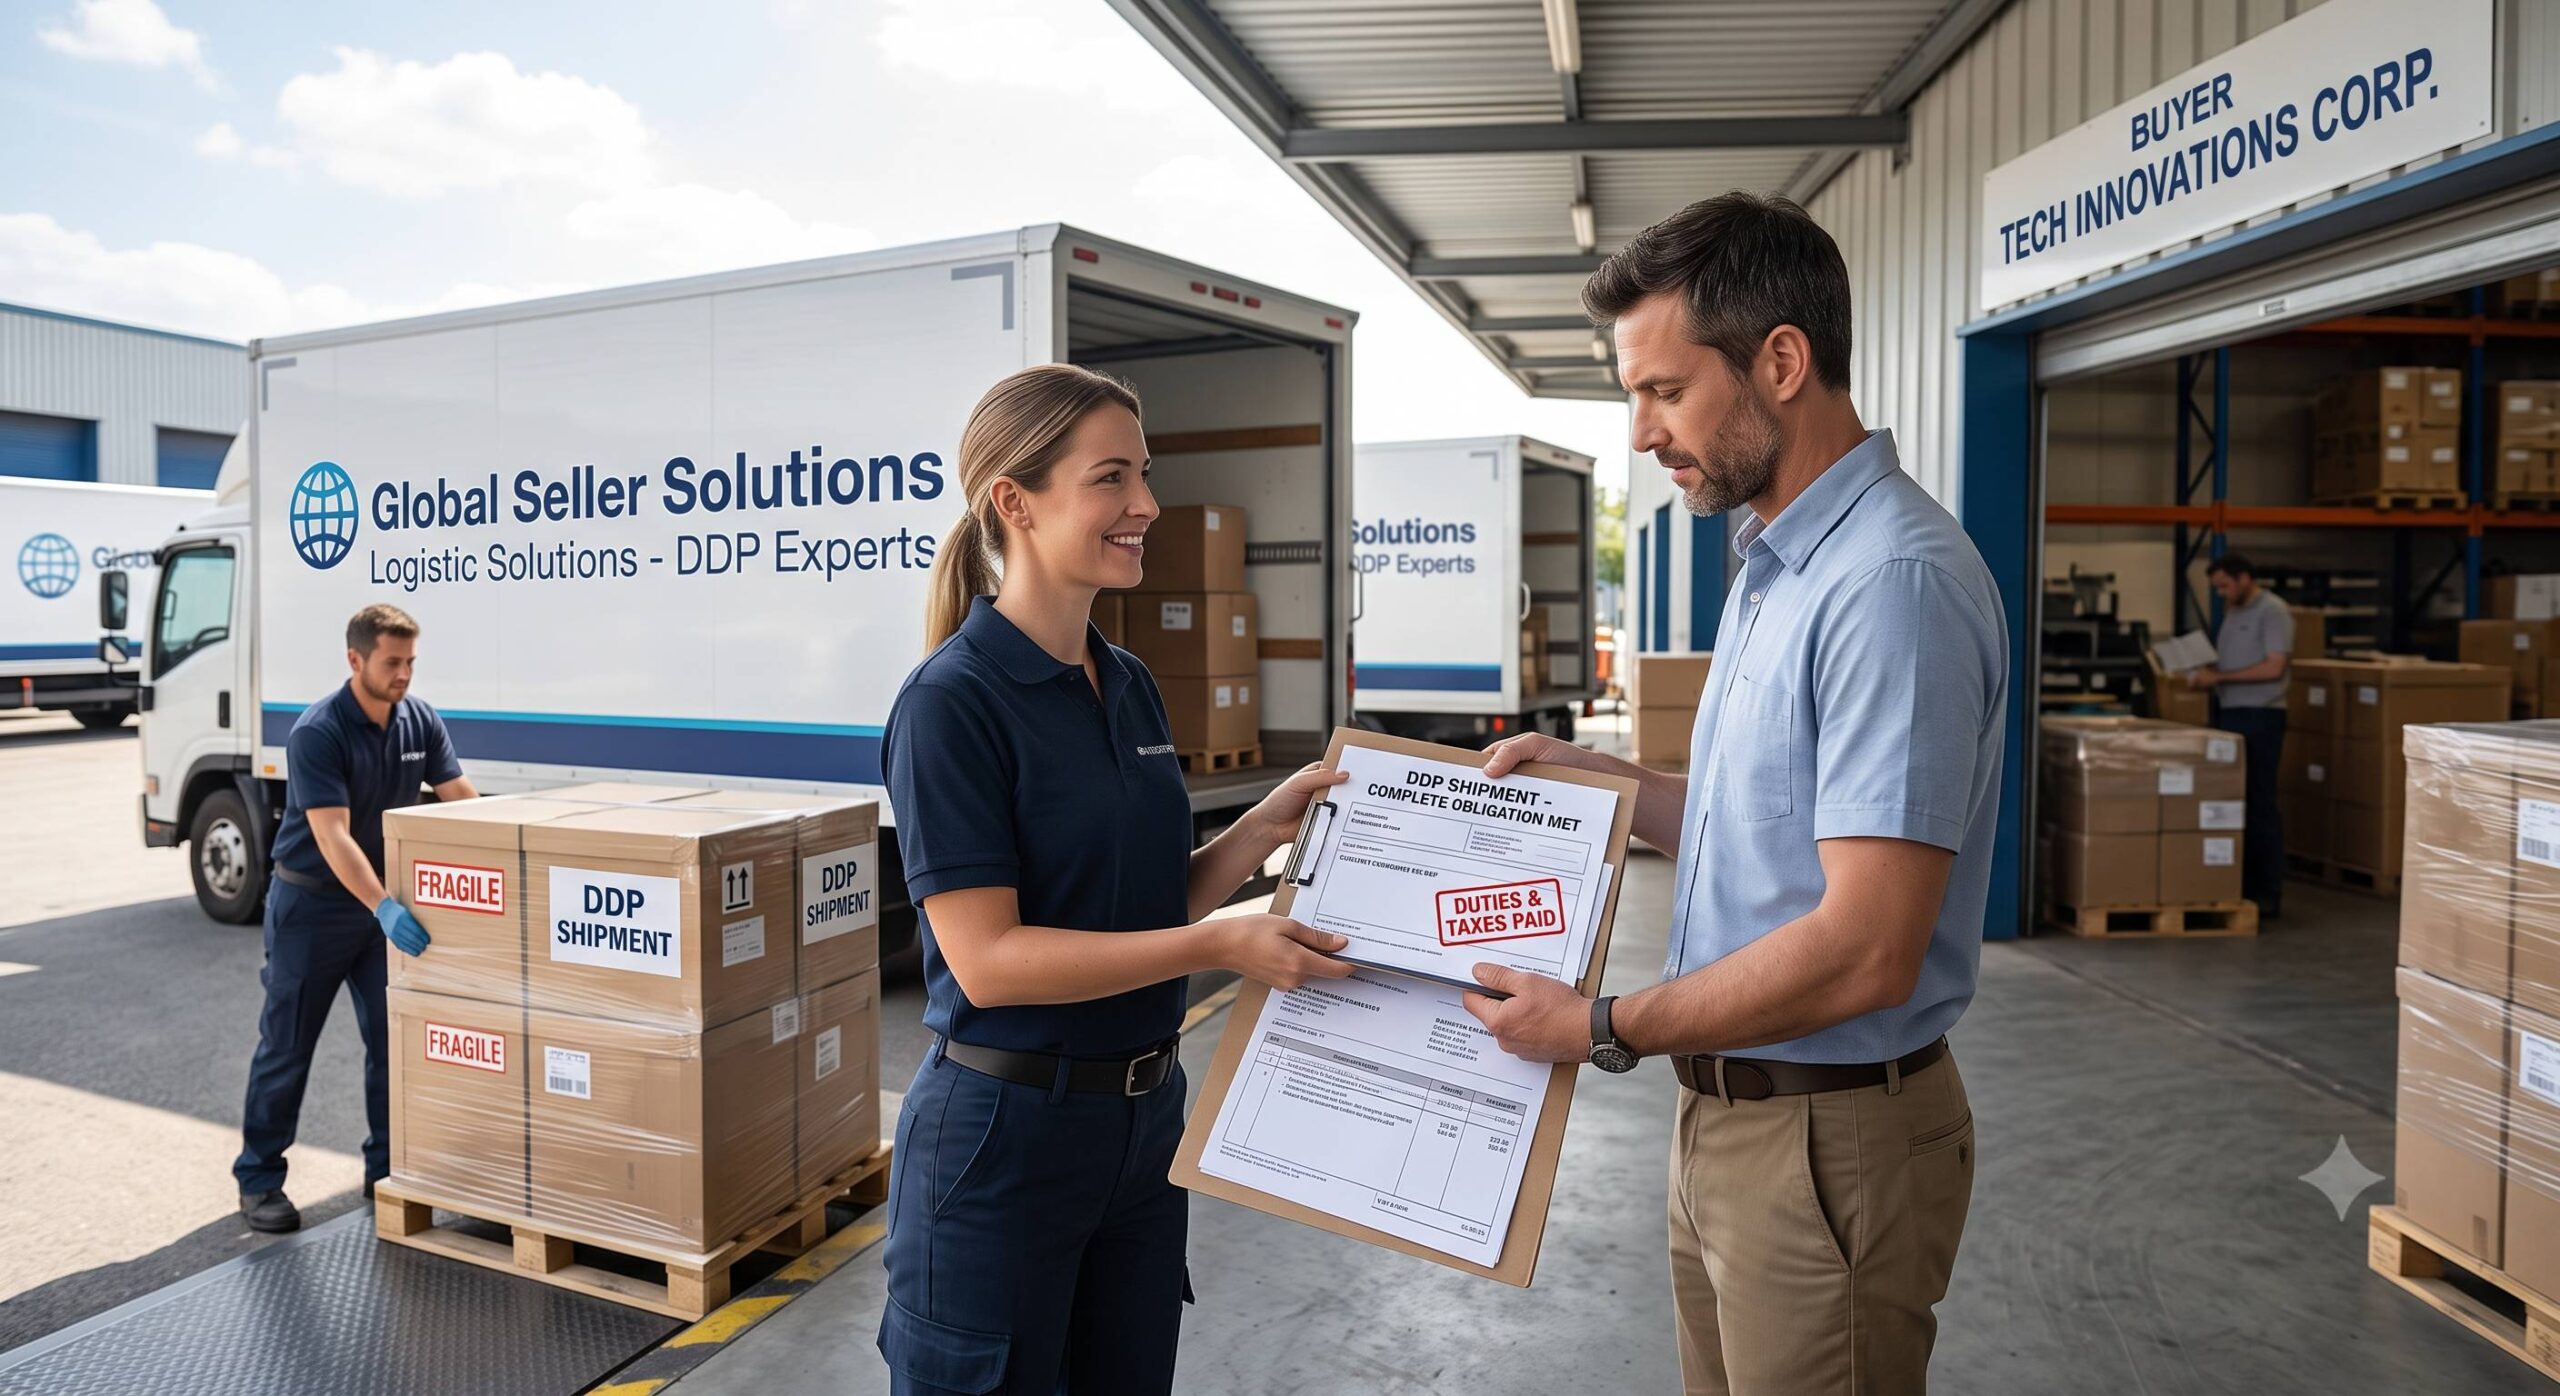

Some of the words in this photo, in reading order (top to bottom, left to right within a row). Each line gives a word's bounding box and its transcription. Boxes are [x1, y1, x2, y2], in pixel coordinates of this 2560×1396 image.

[2131, 72, 2234, 153] BUYER
[1999, 199, 2067, 265] TECH
[2076, 104, 2299, 238] INNOVATIONS
[2312, 47, 2439, 142] CORP.
[371, 473, 498, 532] Global
[512, 462, 648, 529] Seller
[662, 451, 944, 515] Solutions
[371, 543, 478, 593] Logistic
[487, 542, 638, 582] Solutions
[677, 532, 761, 577] DDP
[775, 527, 936, 583] Experts
[1397, 554, 1475, 579] Experts
[1406, 770, 1444, 789] DDP
[1447, 778, 1541, 806] SHIPMENT
[1367, 783, 1449, 809] COMPLETE
[1451, 798, 1544, 826] OBLIGATION
[1547, 814, 1583, 832] MET
[417, 869, 501, 906] FRAGILE
[822, 861, 857, 894] DDP
[584, 884, 645, 919] DDP
[806, 888, 871, 927] SHIPMENT
[1453, 891, 1523, 915] DUTIES
[1527, 889, 1542, 908] &
[557, 919, 673, 957] SHIPMENT
[1446, 914, 1508, 937] TAXES
[1511, 909, 1556, 929] PAID
[429, 1029, 502, 1065] FRAGILE
